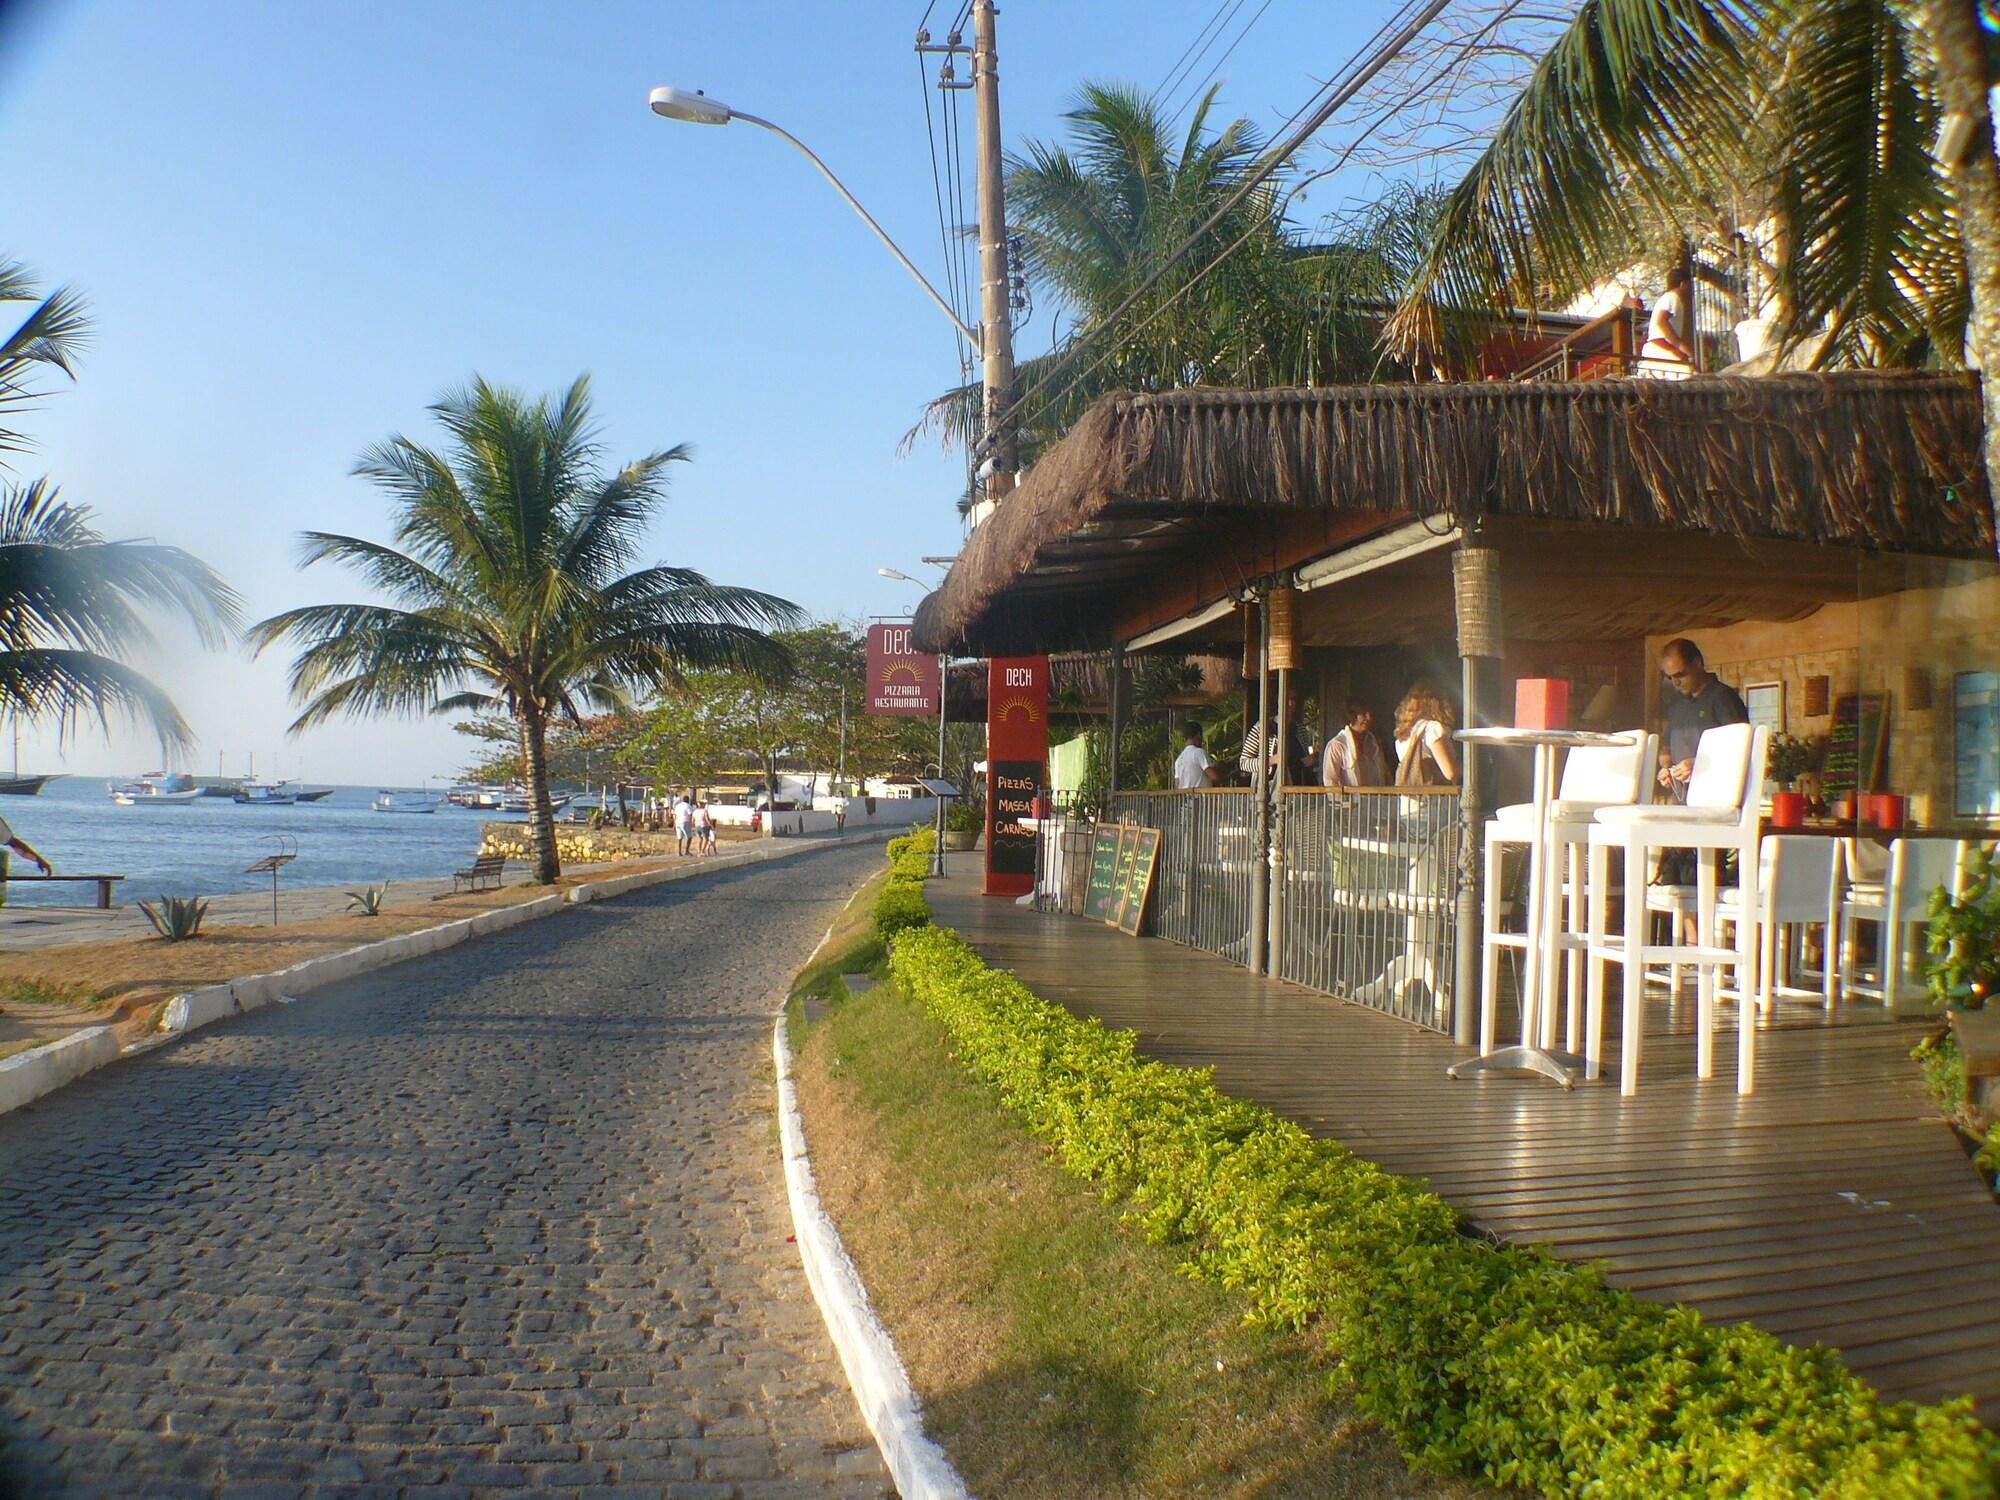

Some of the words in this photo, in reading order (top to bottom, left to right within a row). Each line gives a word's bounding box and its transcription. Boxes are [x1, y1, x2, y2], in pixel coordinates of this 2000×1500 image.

[884, 685, 920, 696] PIZZARIA
[874, 698, 929, 709] RESTAURANTE
[998, 776, 1034, 791] PIZZAS
